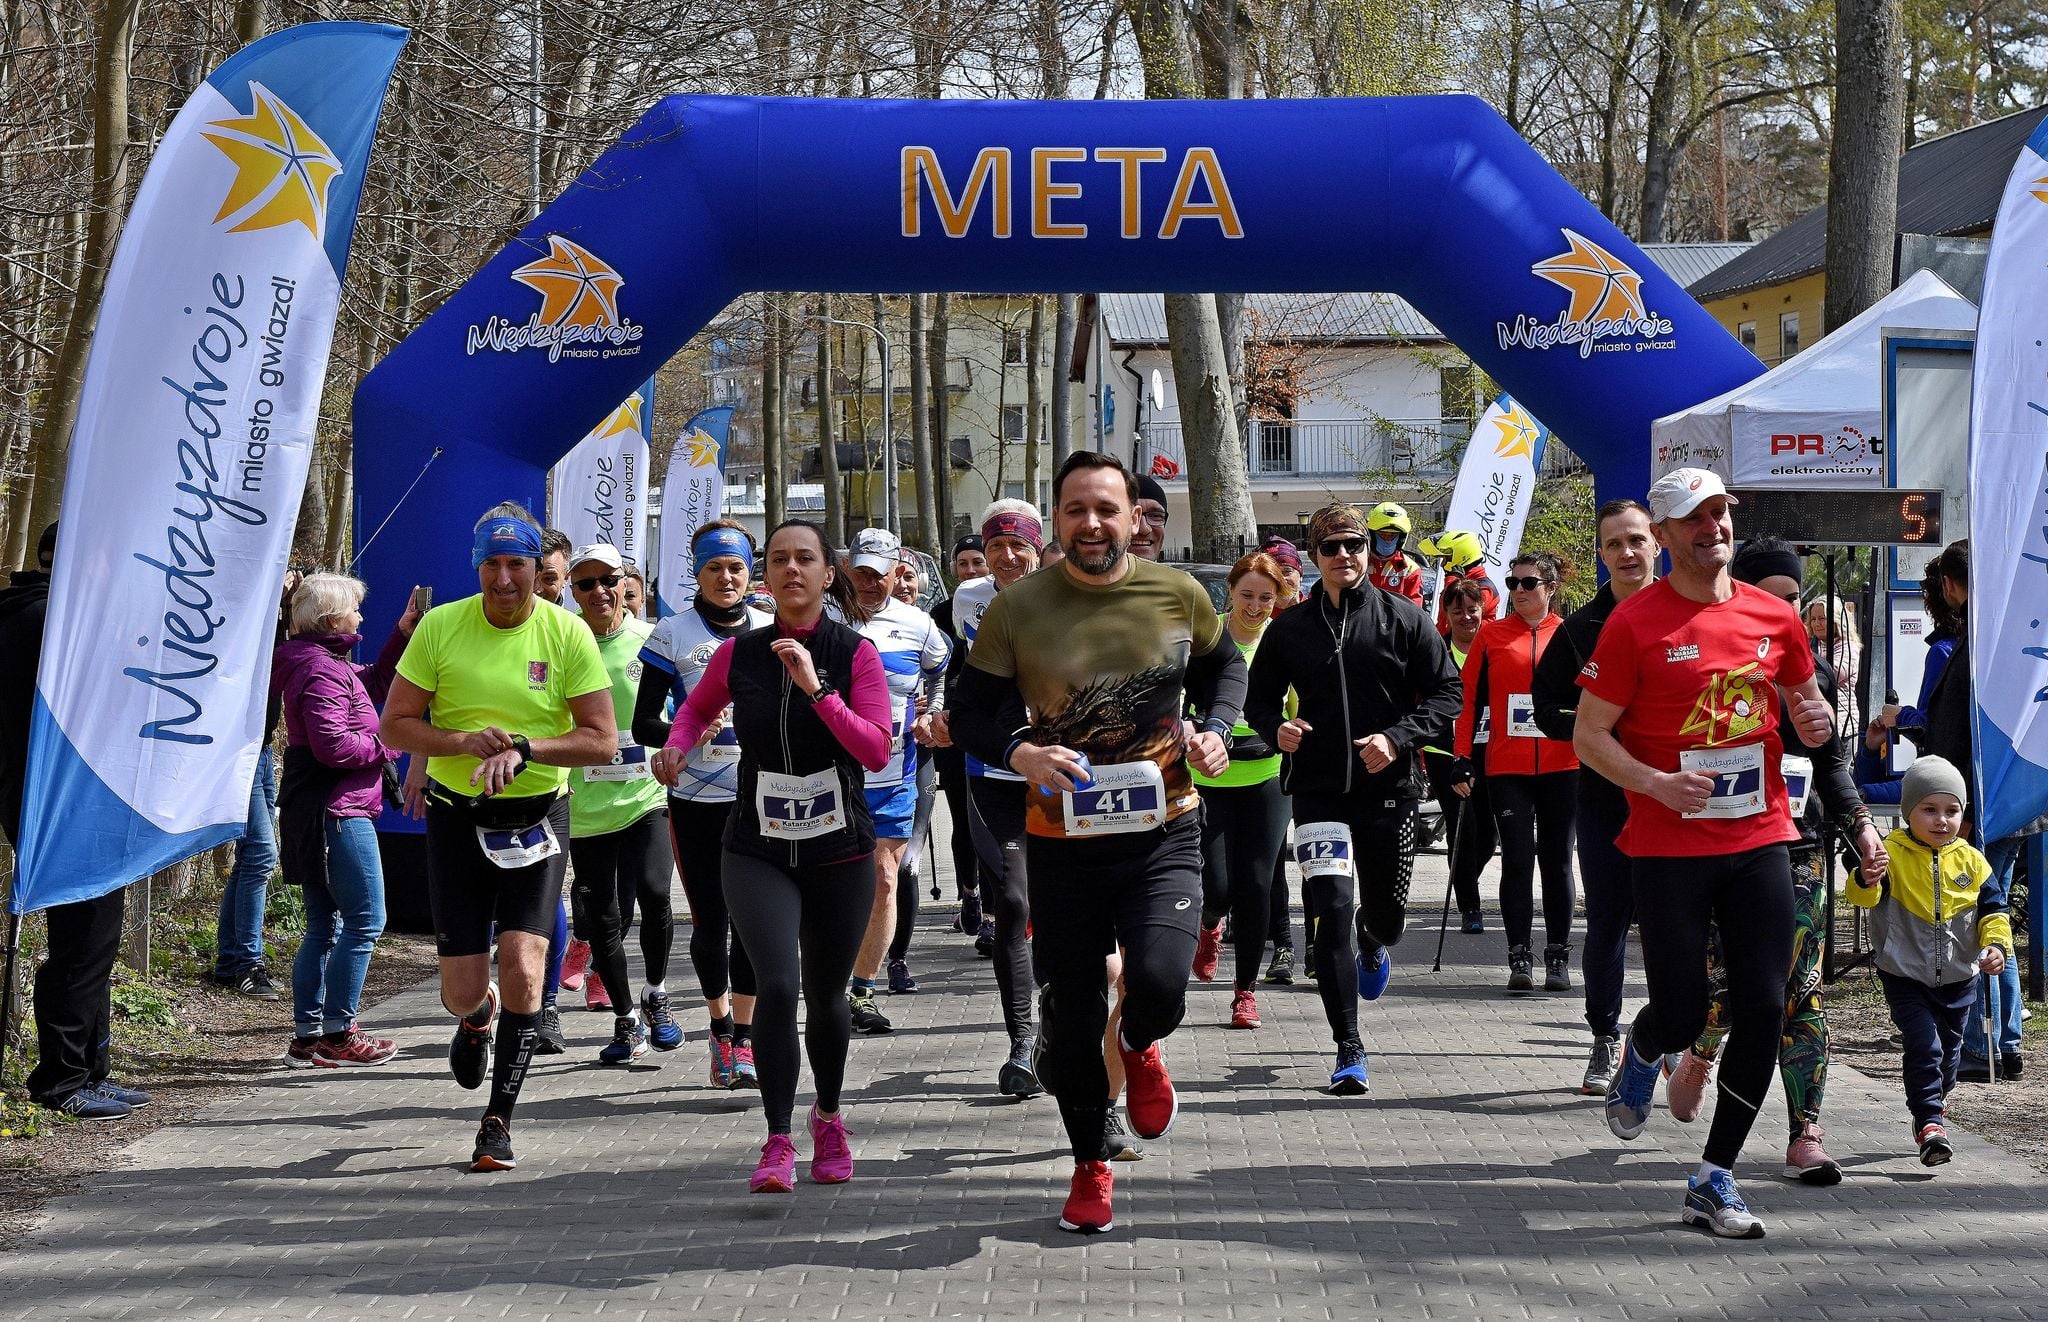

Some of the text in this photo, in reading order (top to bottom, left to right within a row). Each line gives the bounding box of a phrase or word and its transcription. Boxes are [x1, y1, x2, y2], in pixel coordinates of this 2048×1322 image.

[901, 146, 1245, 239] META
[467, 313, 643, 363] Międzyzdroje
[1497, 309, 1674, 358] Międzyzdroje
[562, 345, 641, 359] miasto gwiazd!
[1594, 339, 1677, 353] miasto gwiazd!
[239, 275, 298, 493] miasto gwiazd!
[1771, 465, 1874, 475] elektroniczny
[623, 453, 635, 551] miasto gwiazd!
[705, 477, 713, 507] gwiazd!
[123, 272, 268, 744] Międzyzdroje
[1495, 473, 1522, 554] miasto gwiazd!
[1902, 494, 1926, 541] 5
[1667, 653, 1700, 663] MARATHON
[1673, 649, 1699, 657] WARSAW
[1679, 644, 1698, 652] ORLEN
[1722, 773, 1739, 795] 7
[783, 799, 815, 820] 17
[1095, 789, 1130, 812] 41
[782, 818, 821, 828] Katarzyna
[1307, 841, 1334, 858] 12
